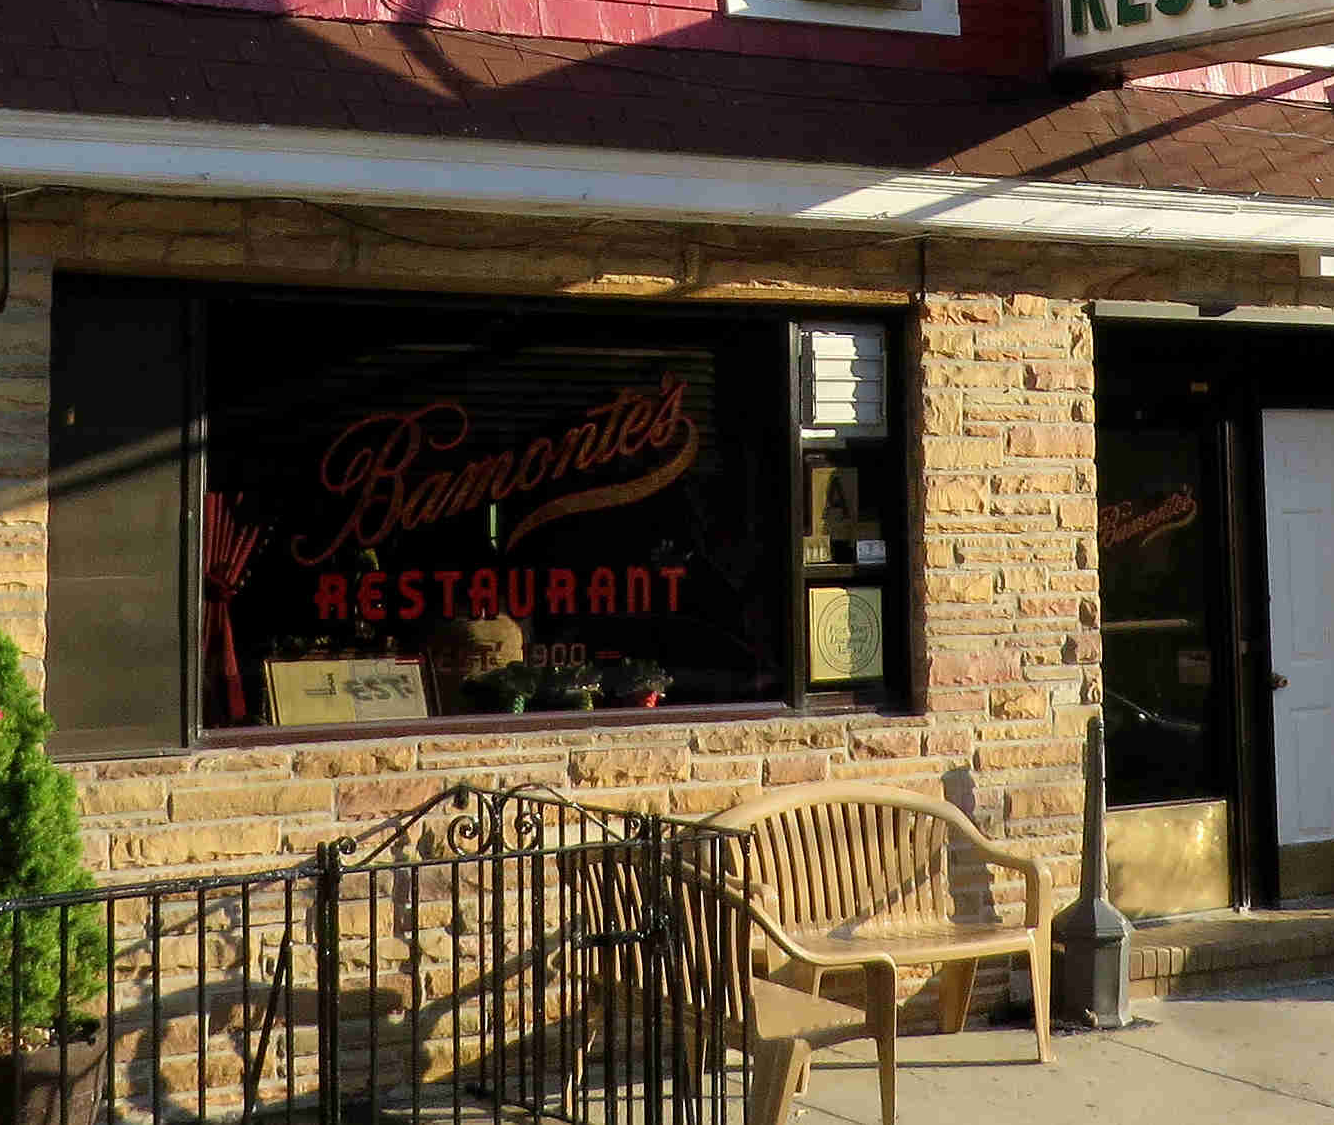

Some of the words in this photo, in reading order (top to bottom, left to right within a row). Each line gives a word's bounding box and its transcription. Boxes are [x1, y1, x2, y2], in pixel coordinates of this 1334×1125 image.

[291, 371, 699, 566] Bamonte's
[314, 566, 688, 621] RESTAURANT
[522, 642, 587, 668] 1900
